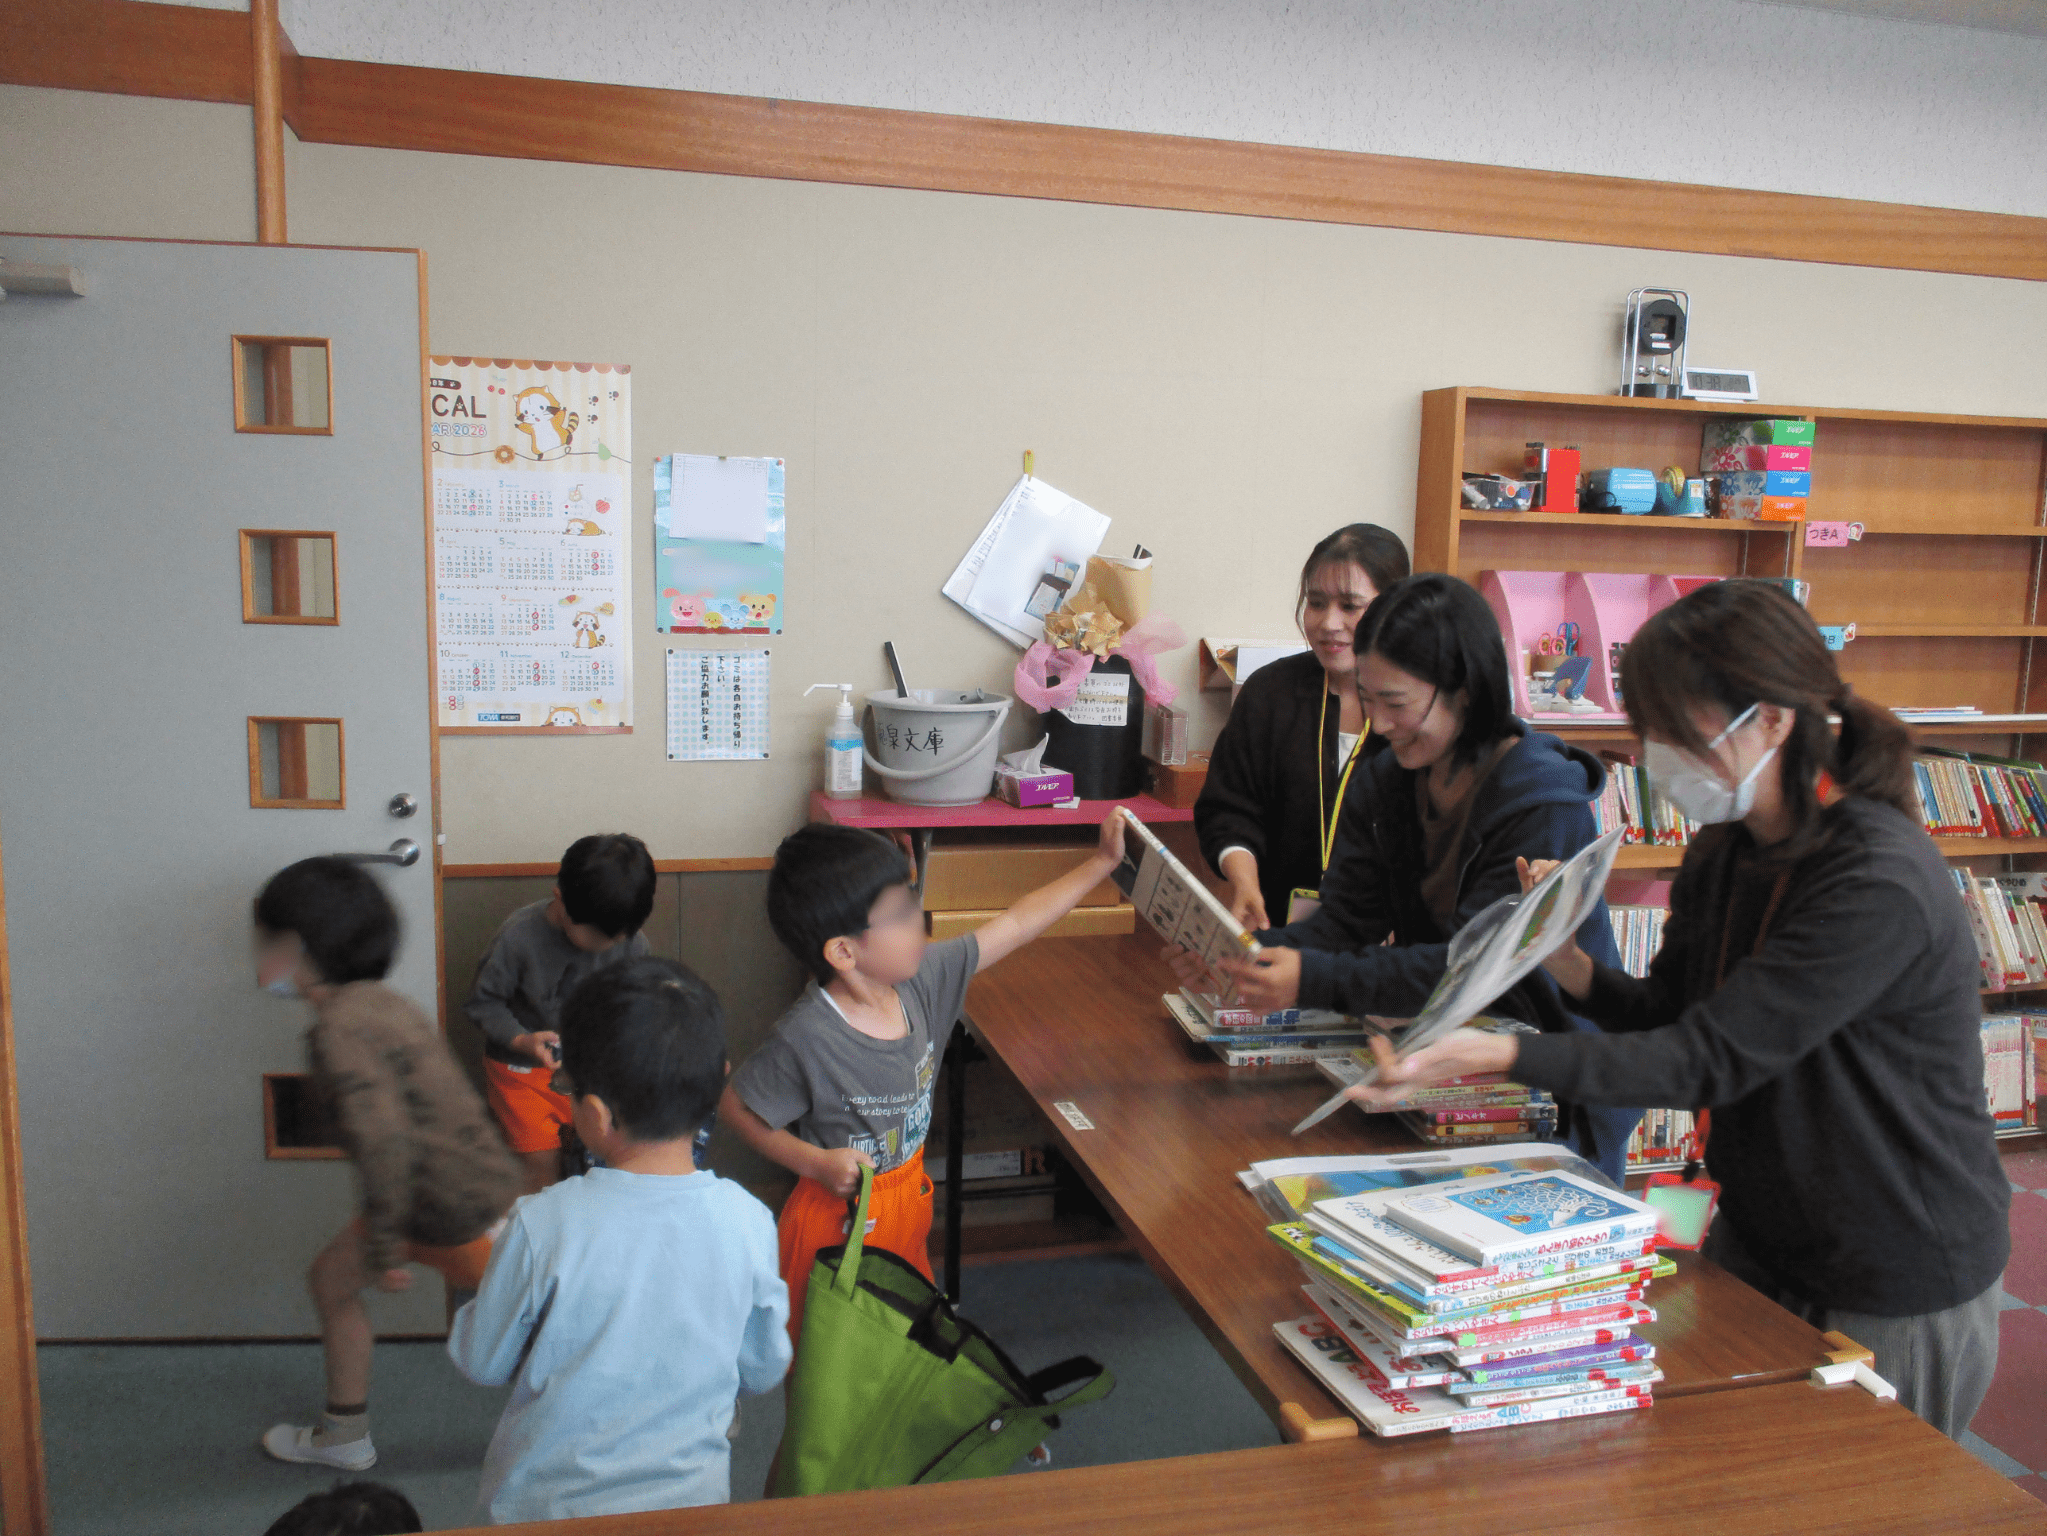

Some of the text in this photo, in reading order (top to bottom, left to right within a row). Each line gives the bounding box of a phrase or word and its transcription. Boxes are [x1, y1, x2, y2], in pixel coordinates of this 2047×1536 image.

[453, 423, 487, 437] 2026
[1809, 528, 1839, 541] つきA
[717, 655, 726, 688] 下さい。
[701, 656, 710, 745] ご協力お願い致します。
[733, 656, 741, 748] ゴミは各自お持ち帰り
[1495, 1402, 1533, 1419] ABC
